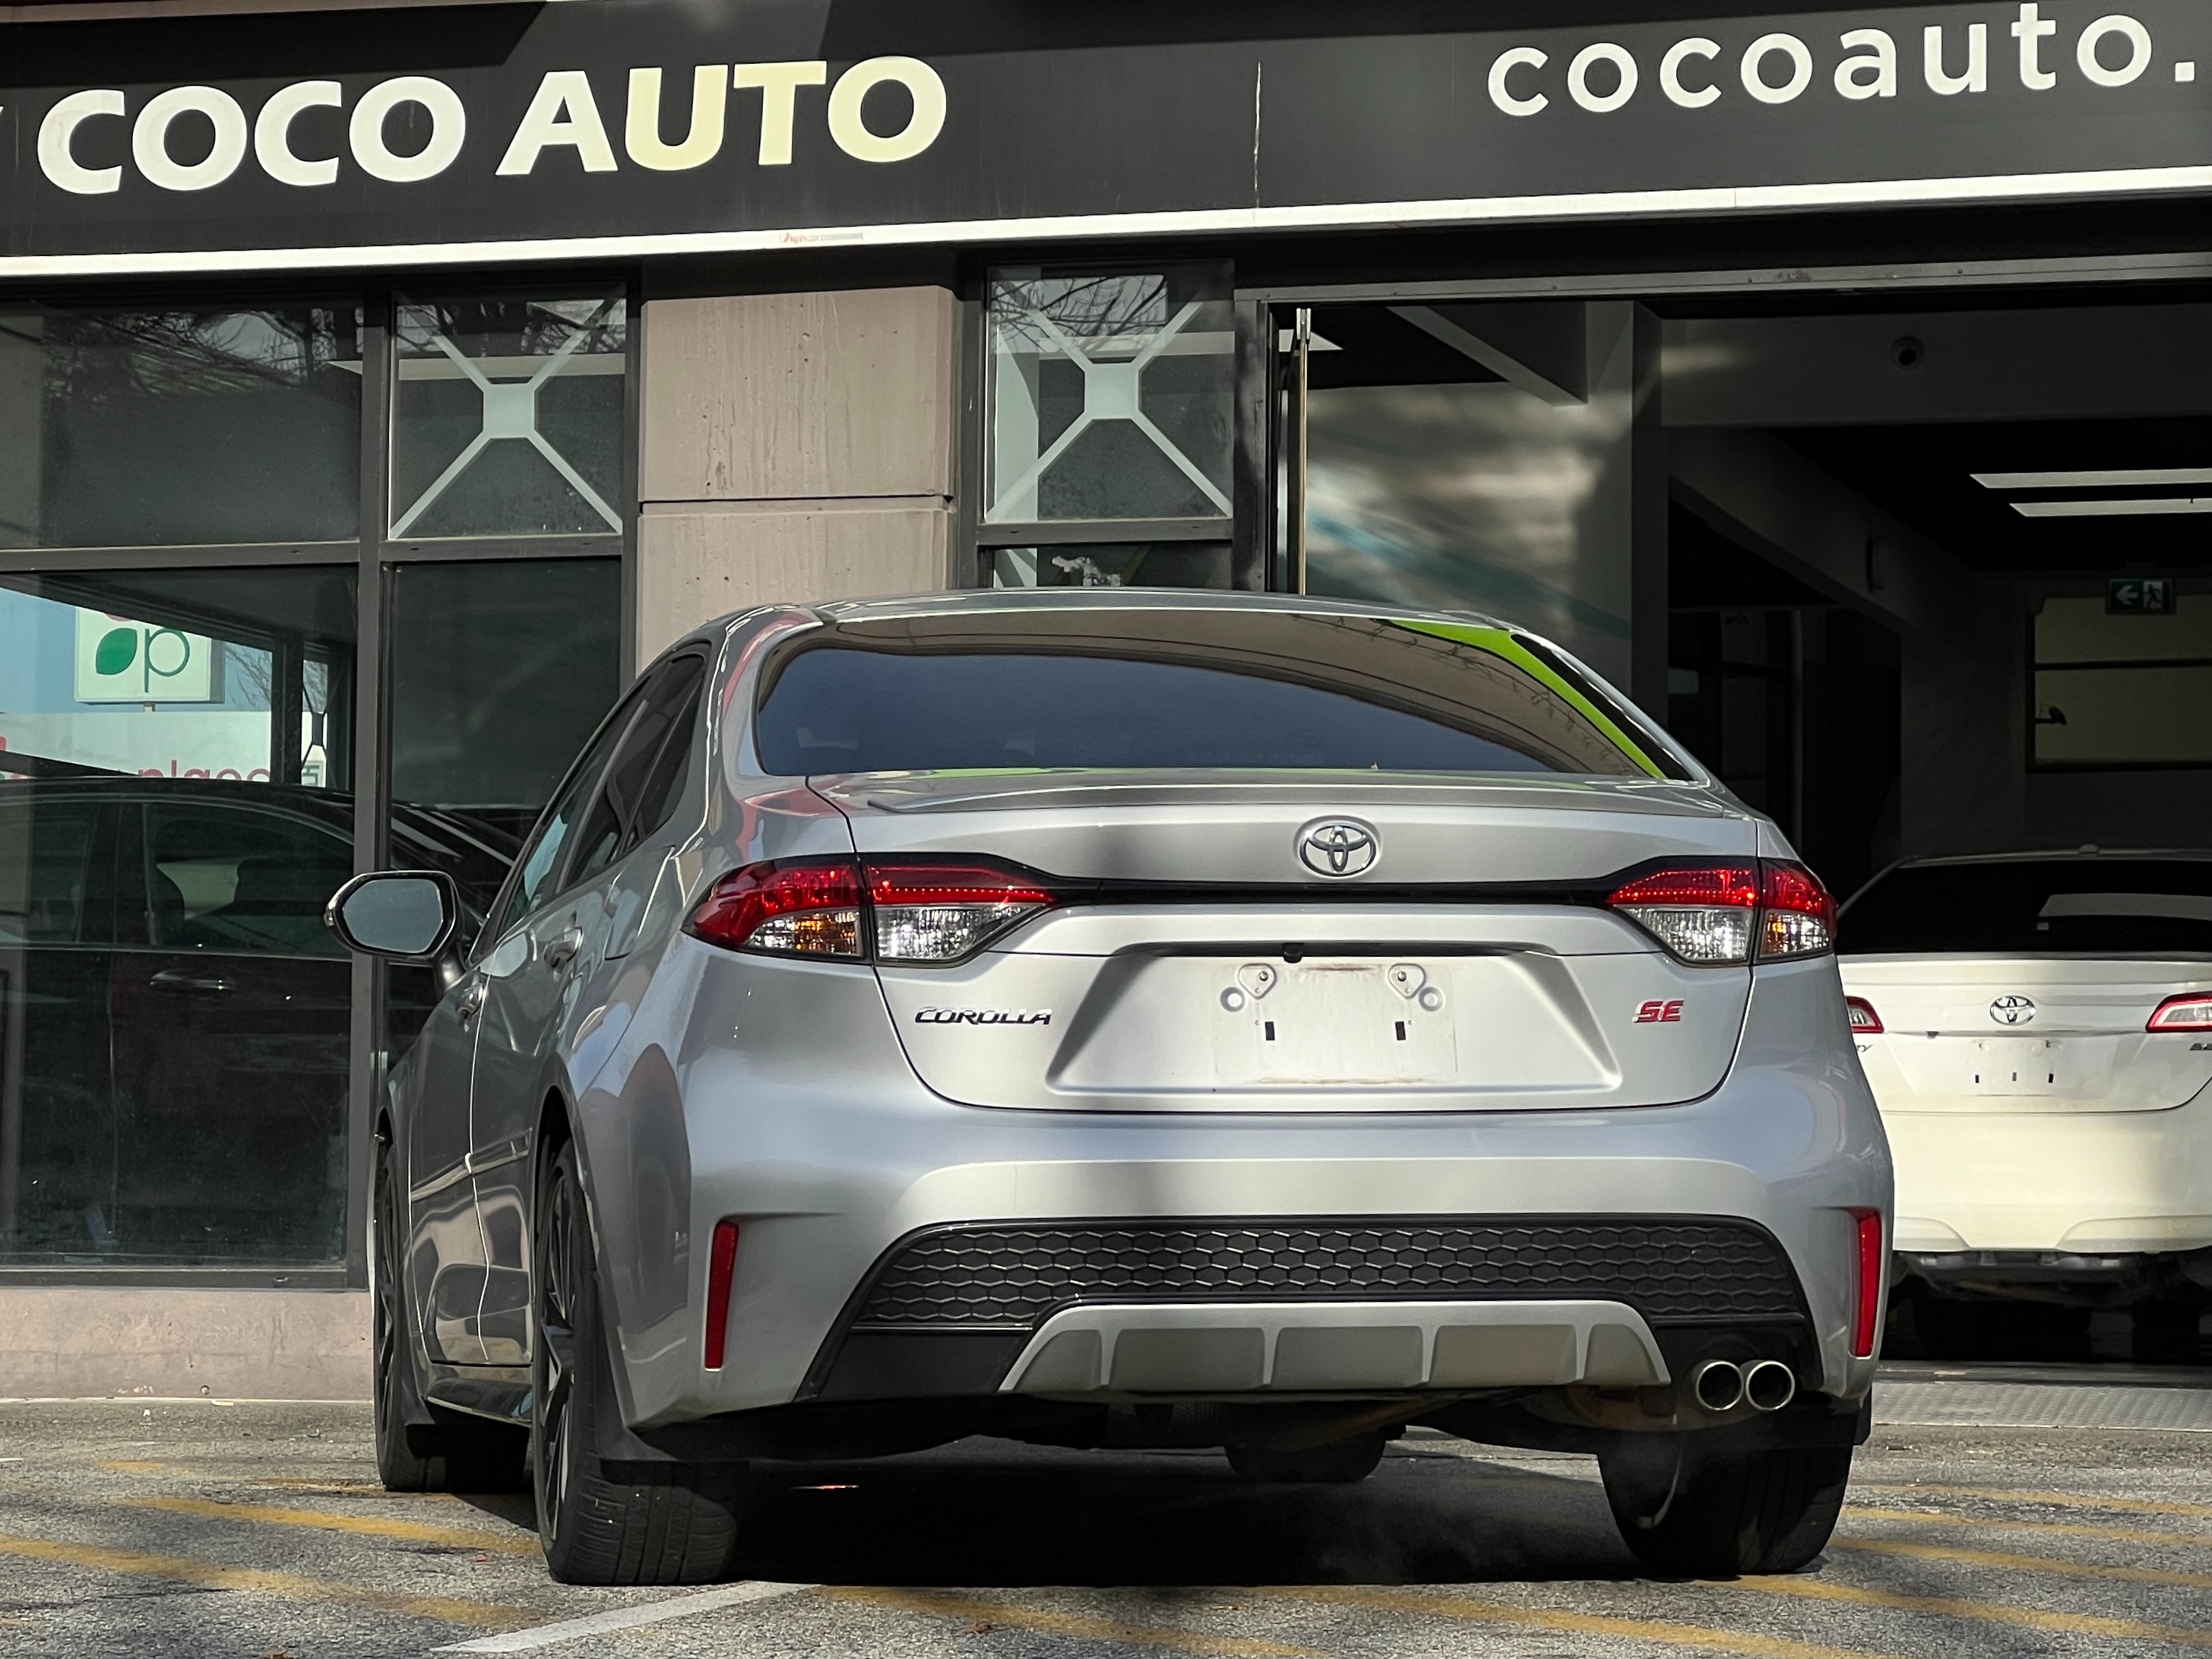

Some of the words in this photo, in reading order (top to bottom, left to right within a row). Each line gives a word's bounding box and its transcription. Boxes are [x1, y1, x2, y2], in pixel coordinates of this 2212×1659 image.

[1488, 2, 2196, 116] cocoauto.
[37, 75, 467, 195] COCO
[495, 55, 947, 176] AUTO
[915, 1006, 1052, 1025] COROLLA
[1632, 999, 1685, 1023] SE
